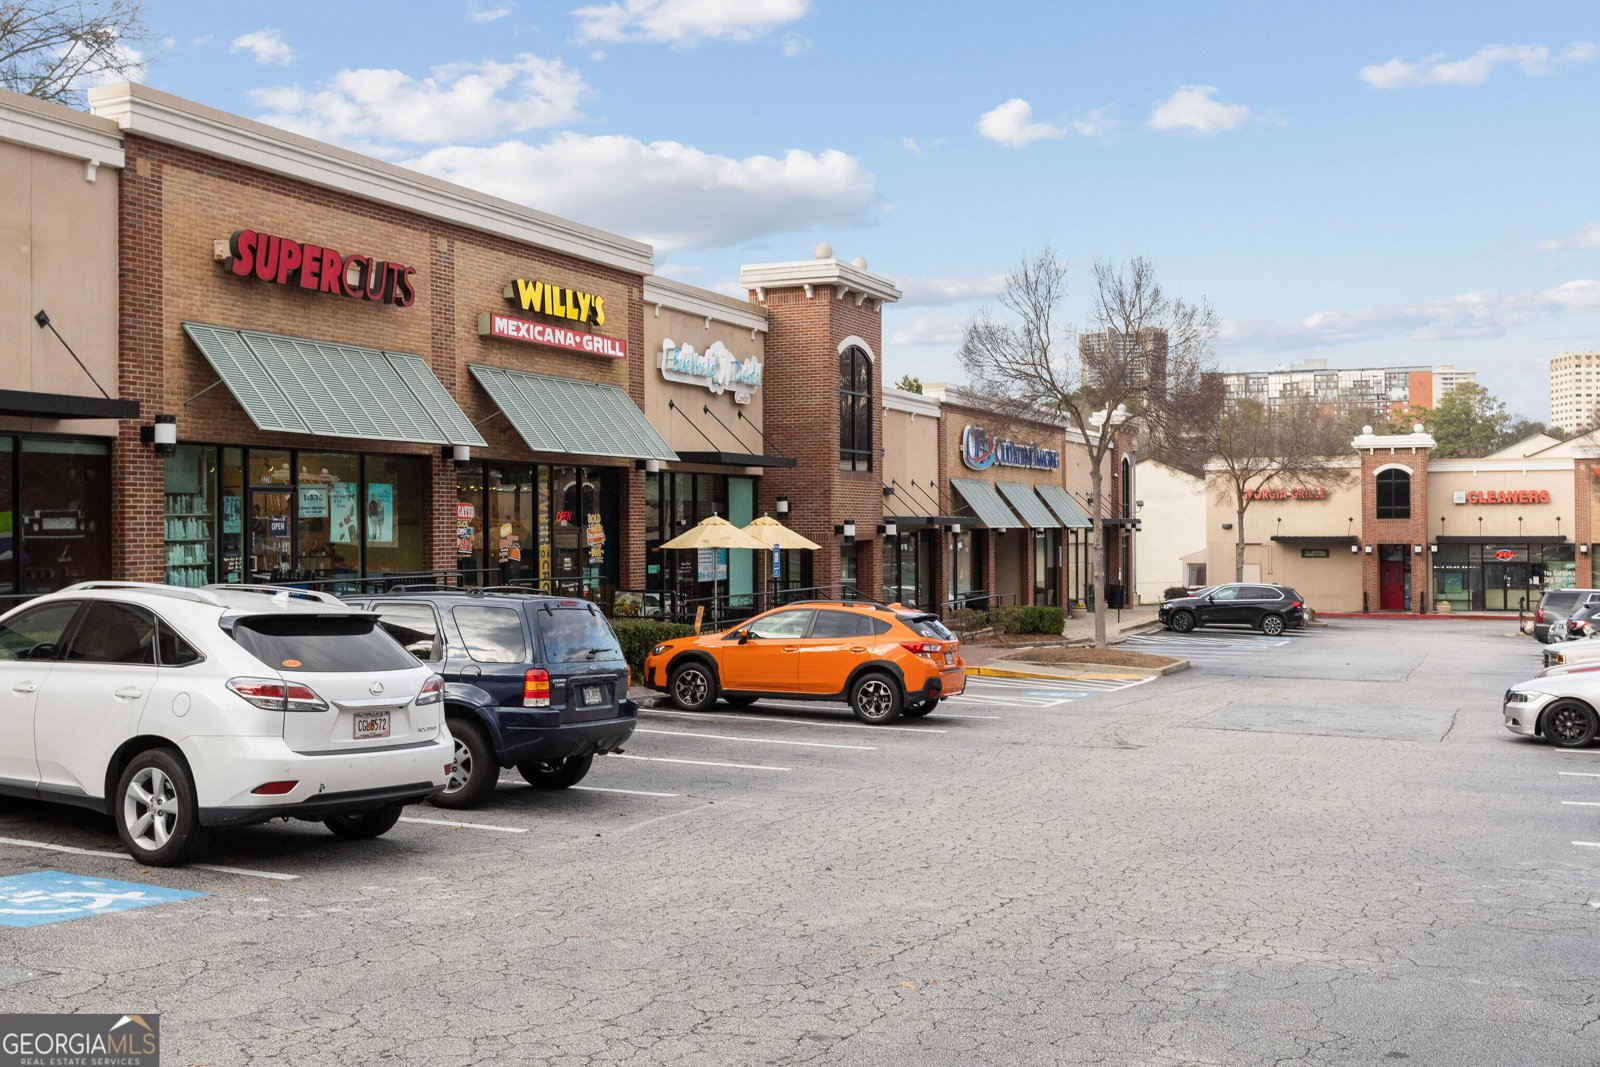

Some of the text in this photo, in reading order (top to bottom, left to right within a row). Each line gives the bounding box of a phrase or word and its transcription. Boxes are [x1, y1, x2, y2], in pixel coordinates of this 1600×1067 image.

[231, 229, 416, 307] SUPERCUTS
[513, 278, 605, 326] WILLY'S
[494, 316, 625, 358] MEXICANA GRILL
[1290, 487, 1327, 499] GRILLE
[1467, 490, 1549, 504] CLEANERS
[555, 511, 571, 522] OPEN
[271, 522, 285, 531] OPEN
[1494, 551, 1515, 560] OPEN
